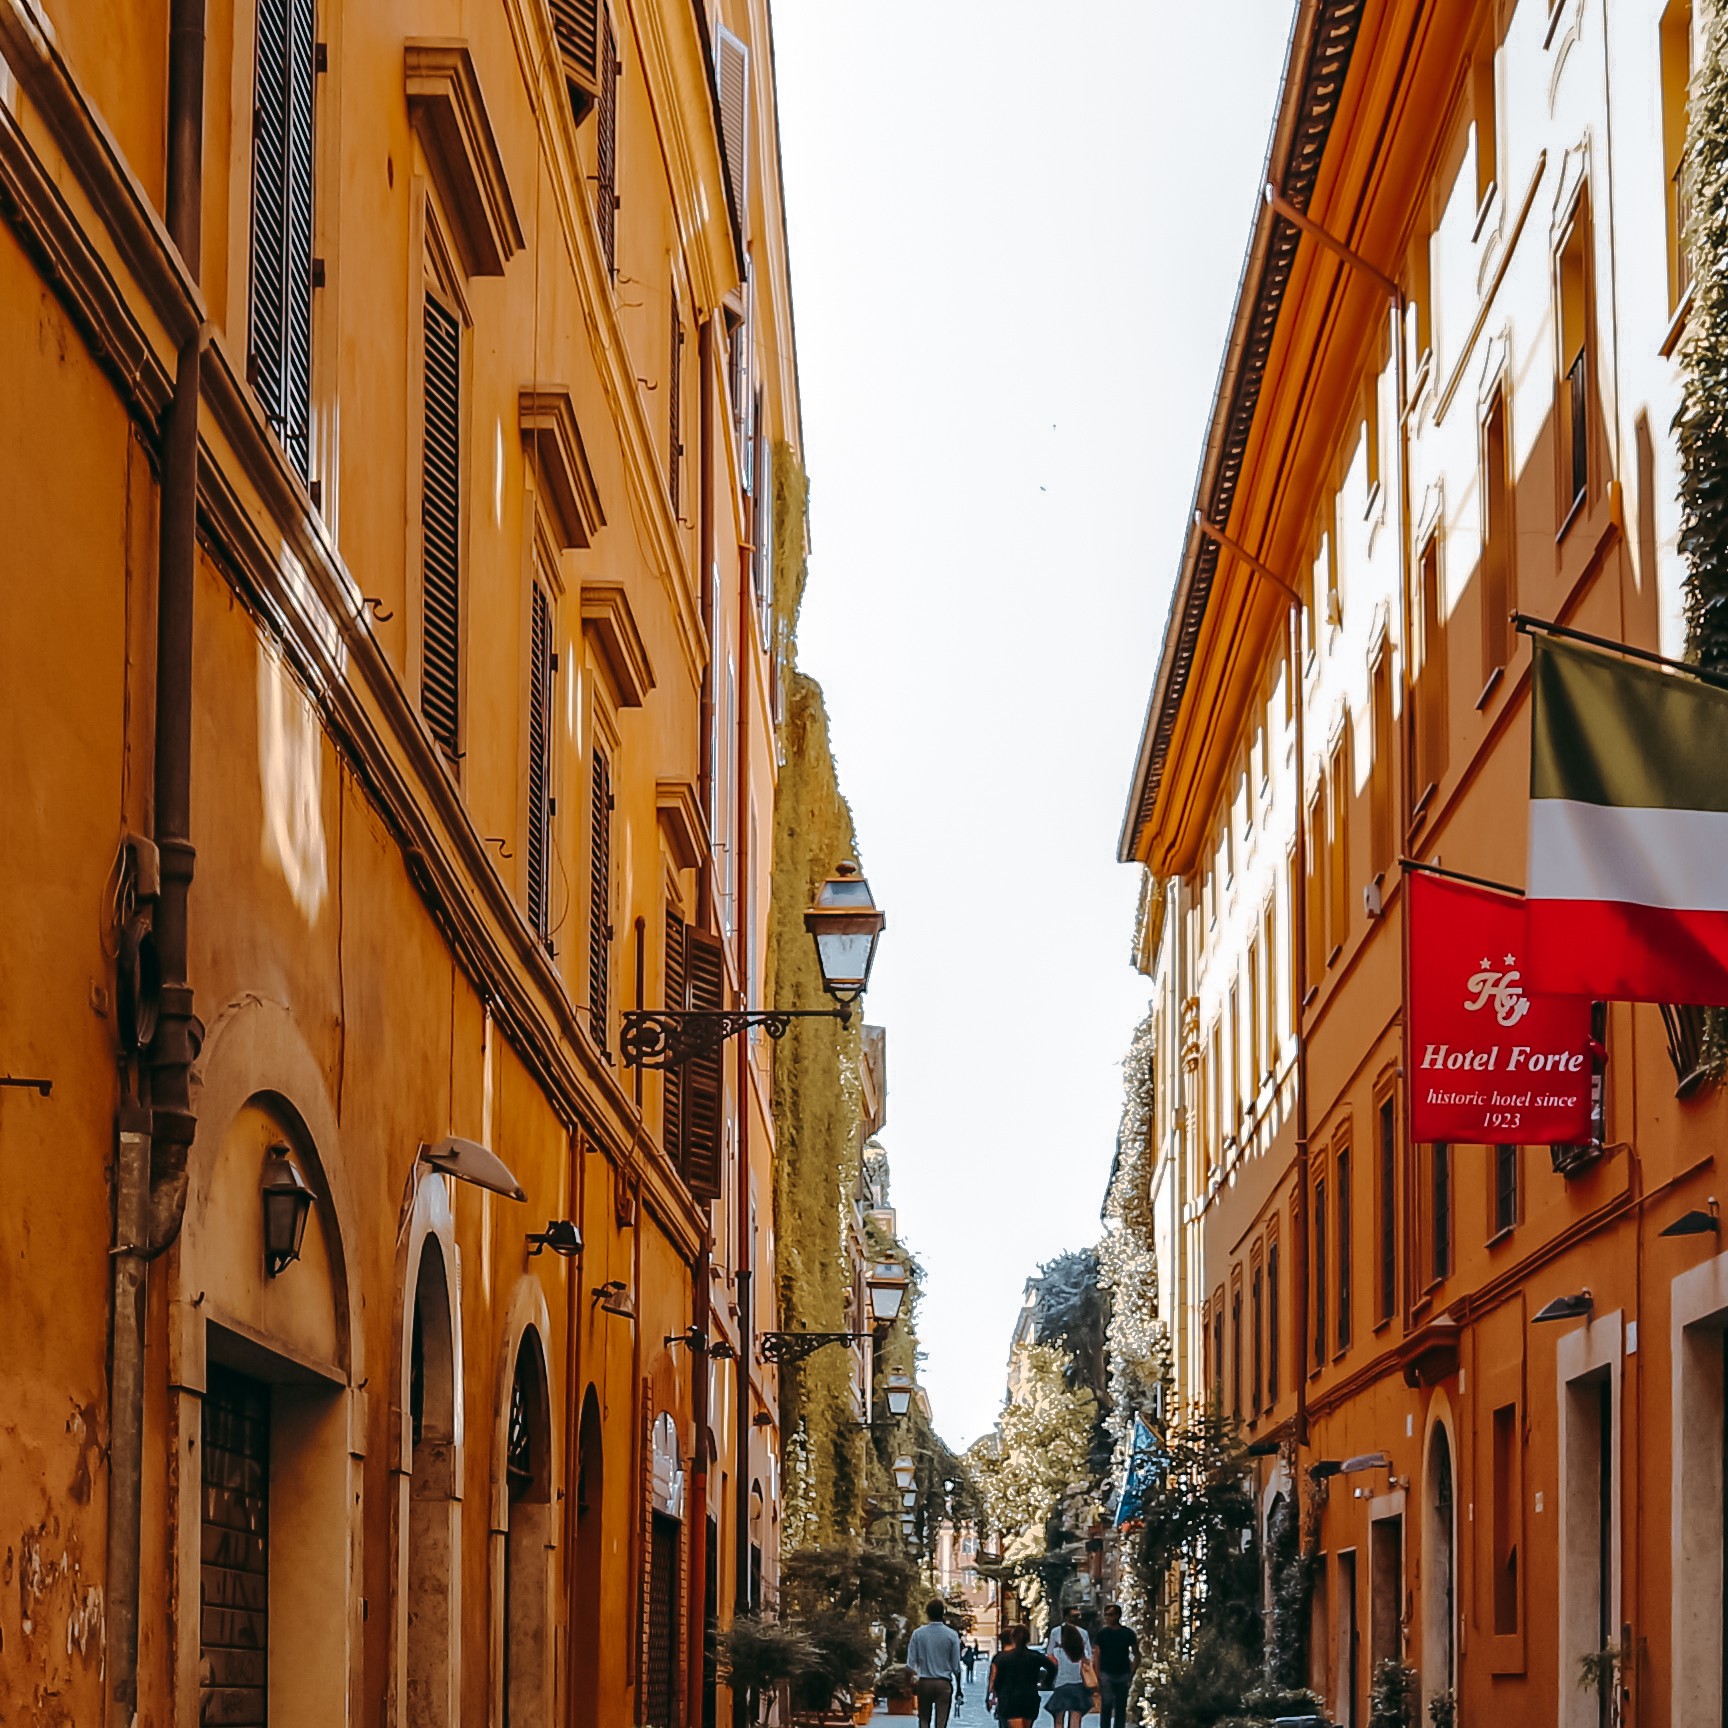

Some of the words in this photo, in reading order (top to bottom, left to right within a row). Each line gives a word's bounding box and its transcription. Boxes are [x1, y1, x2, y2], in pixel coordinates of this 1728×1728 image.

[1420, 1044, 1499, 1071] Hotel
[1506, 1045, 1584, 1073] Forte
[1427, 1088, 1487, 1106] historic
[1491, 1091, 1531, 1107] hotel
[1535, 1093, 1577, 1107] since
[1483, 1112, 1521, 1128] 1923
